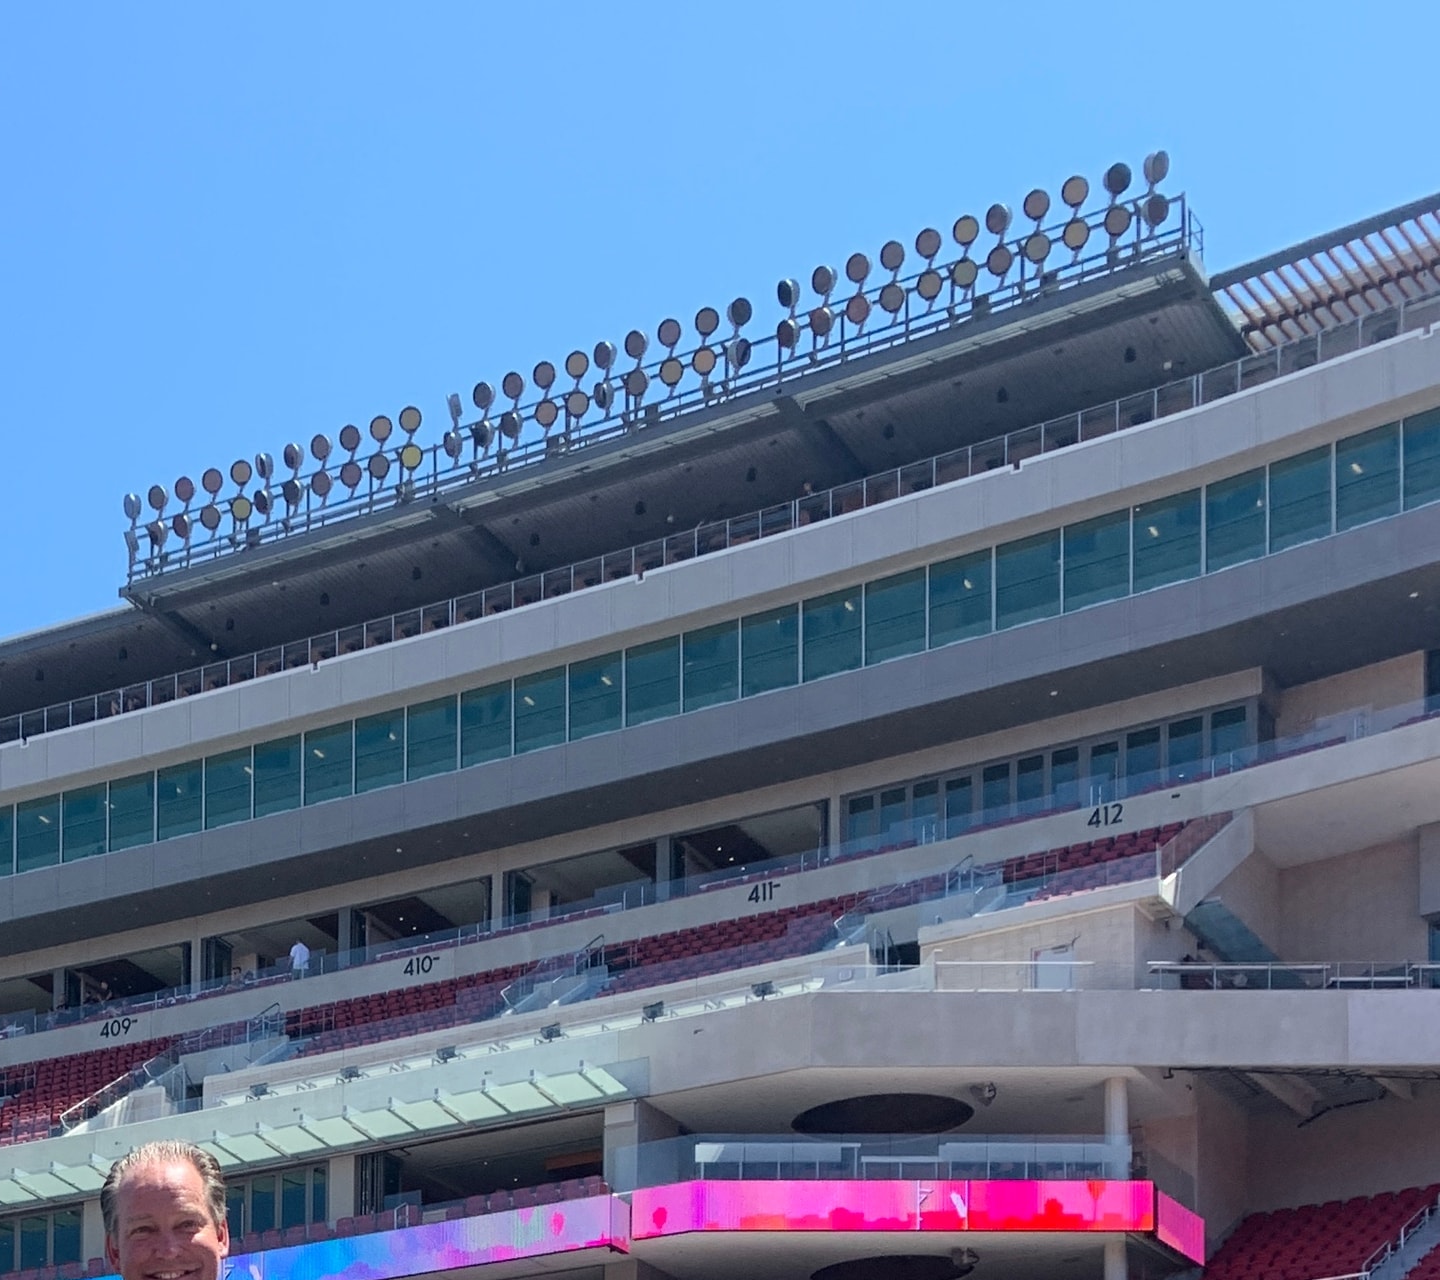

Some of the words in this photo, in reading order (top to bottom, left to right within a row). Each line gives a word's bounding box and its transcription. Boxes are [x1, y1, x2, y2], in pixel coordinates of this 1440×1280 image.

[1087, 802, 1124, 828] 412
[748, 879, 774, 903] 411
[403, 955, 434, 977] 410
[99, 1017, 132, 1039] 409
